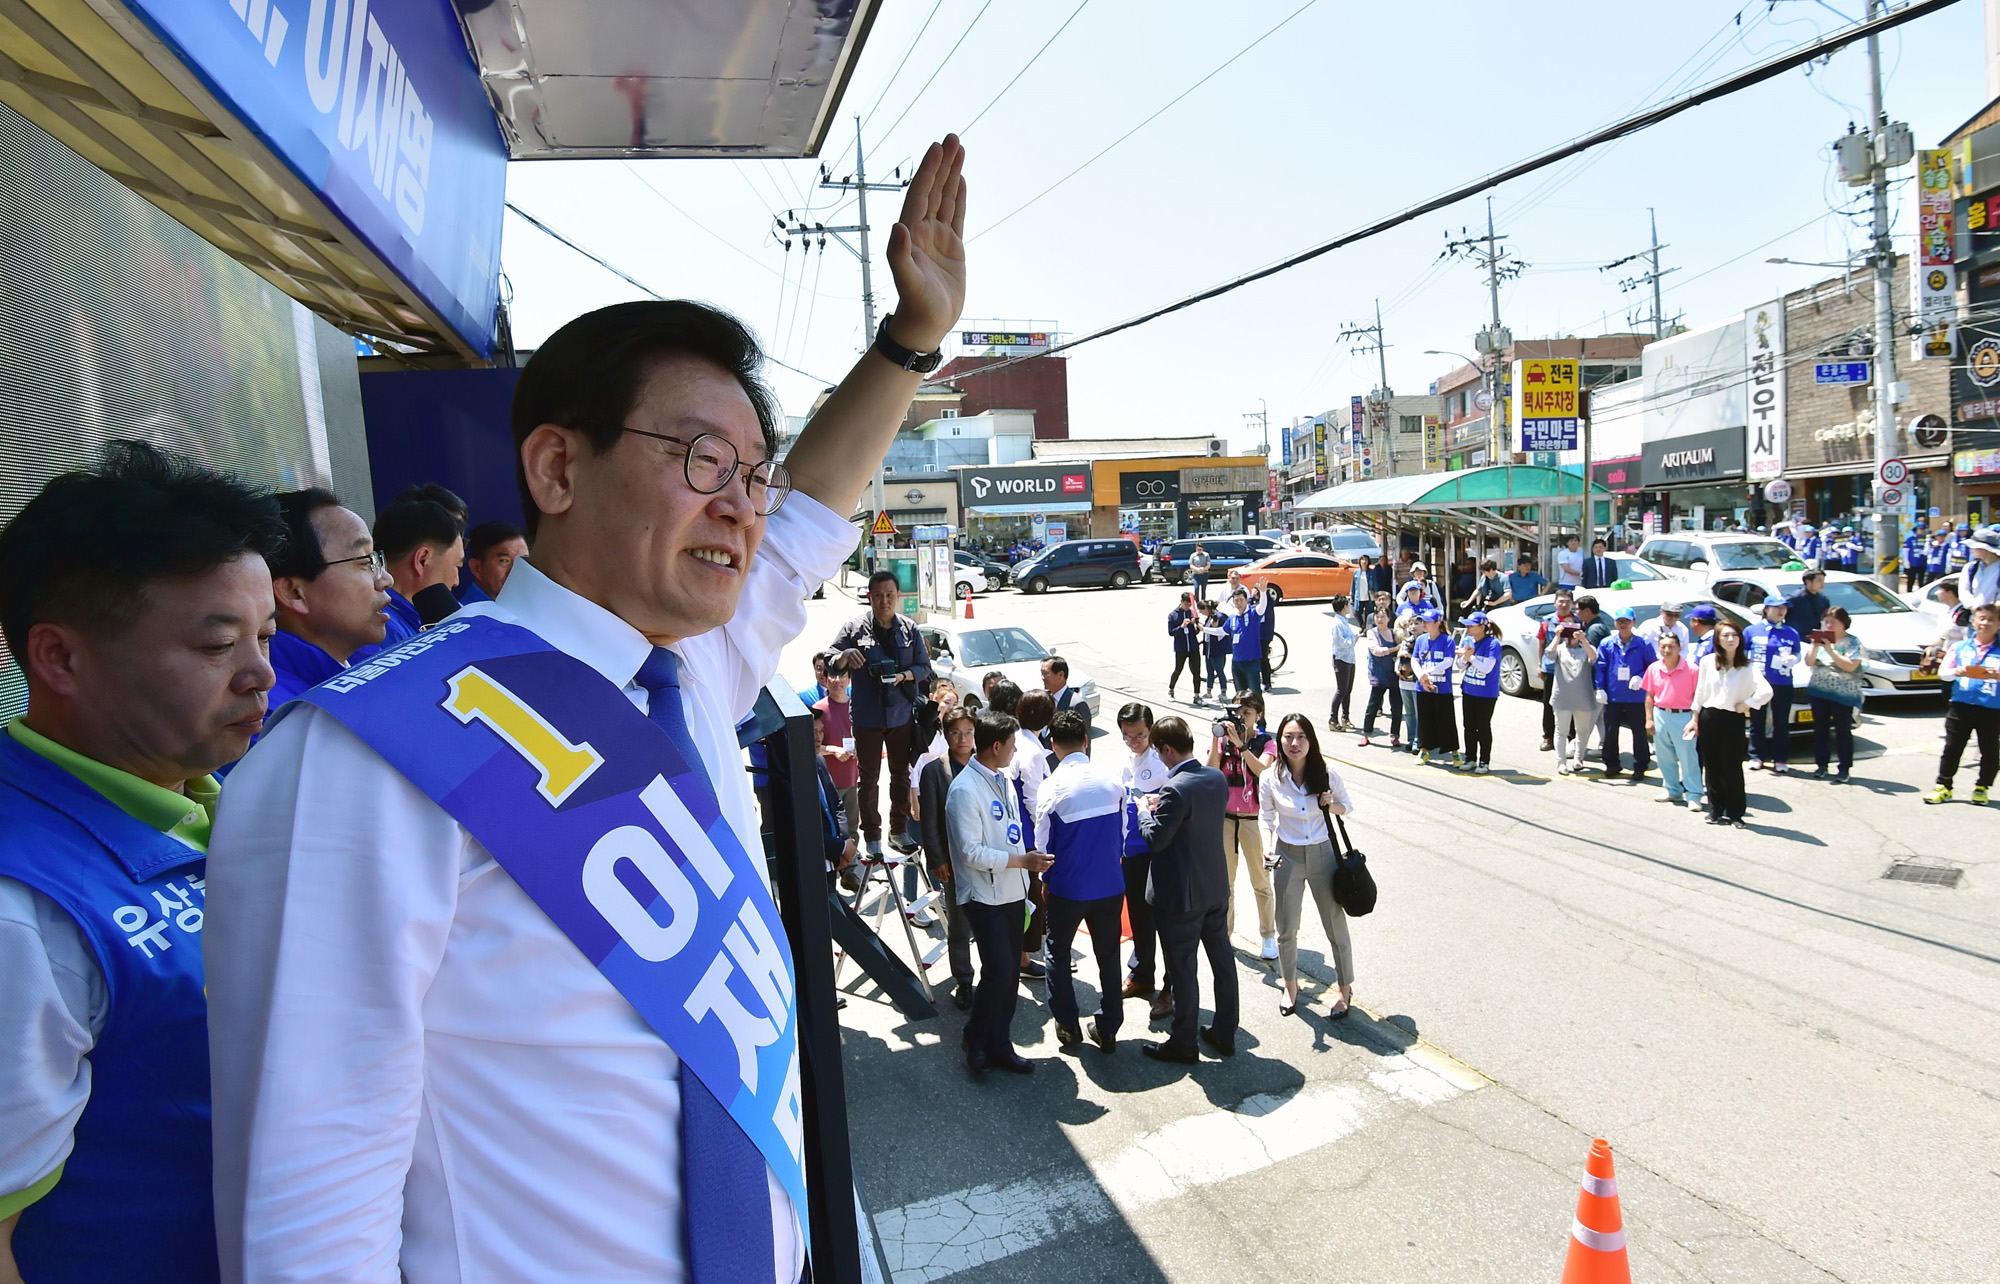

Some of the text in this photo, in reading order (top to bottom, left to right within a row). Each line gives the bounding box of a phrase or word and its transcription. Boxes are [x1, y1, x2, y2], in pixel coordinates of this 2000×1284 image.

[1550, 364, 1573, 384] 전곡
[1524, 390, 1575, 413] 택시주차장
[1751, 351, 1775, 455] 전우사
[1523, 420, 1576, 440] 국민마트
[1661, 448, 1713, 468] ARITAUM
[1885, 465, 1901, 479] 30
[996, 479, 1056, 494] WORLD
[321, 621, 472, 694] 더불어민주당
[441, 664, 606, 809] 1
